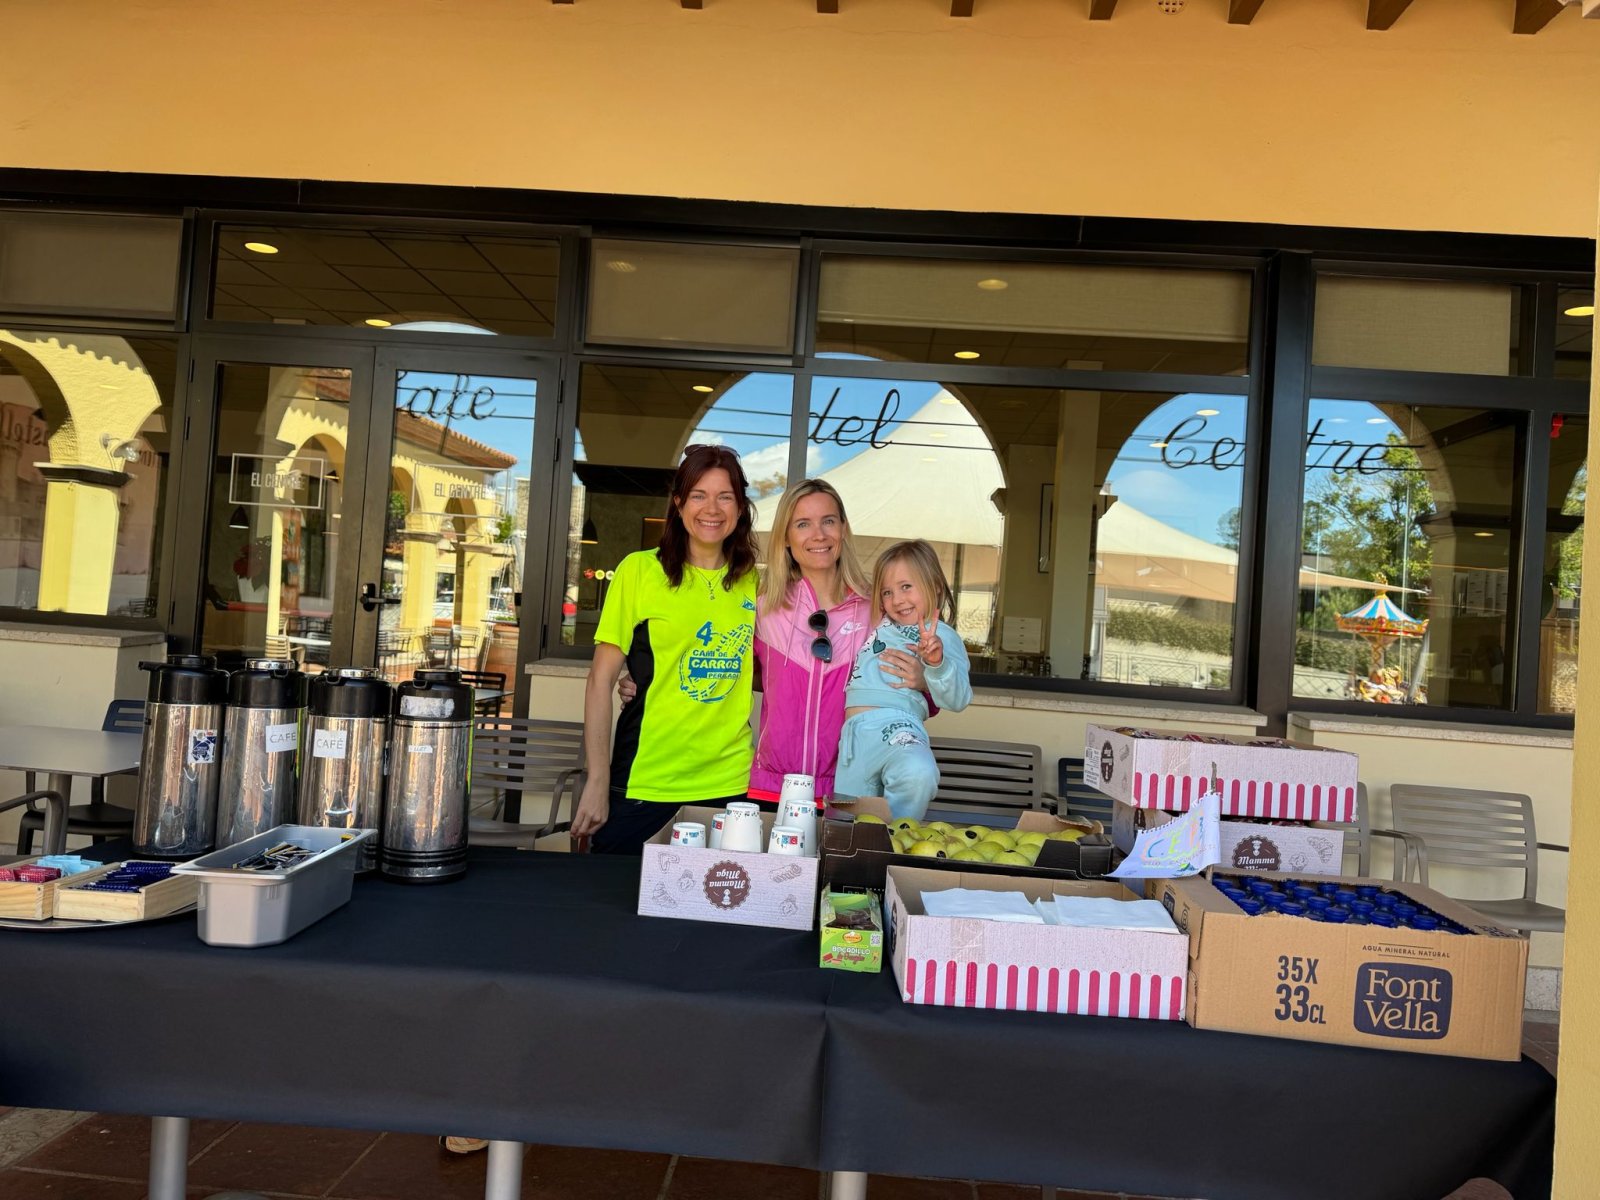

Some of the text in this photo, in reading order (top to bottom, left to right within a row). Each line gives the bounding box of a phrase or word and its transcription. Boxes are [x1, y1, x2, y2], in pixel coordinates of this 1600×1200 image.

[1161, 414, 1390, 475] Cetre
[434, 483, 486, 499] EL CENTRE
[696, 621, 712, 647] 4
[691, 659, 739, 669] CARROS
[1237, 856, 1275, 865] Mamma
[716, 869, 741, 879] Miga
[709, 880, 746, 889] Mamma
[1384, 947, 1416, 955] MINERAL
[1418, 950, 1450, 958] NATURAL
[1277, 955, 1320, 985] 35X
[1365, 968, 1442, 1003] Font
[1362, 999, 1441, 1033] Vella
